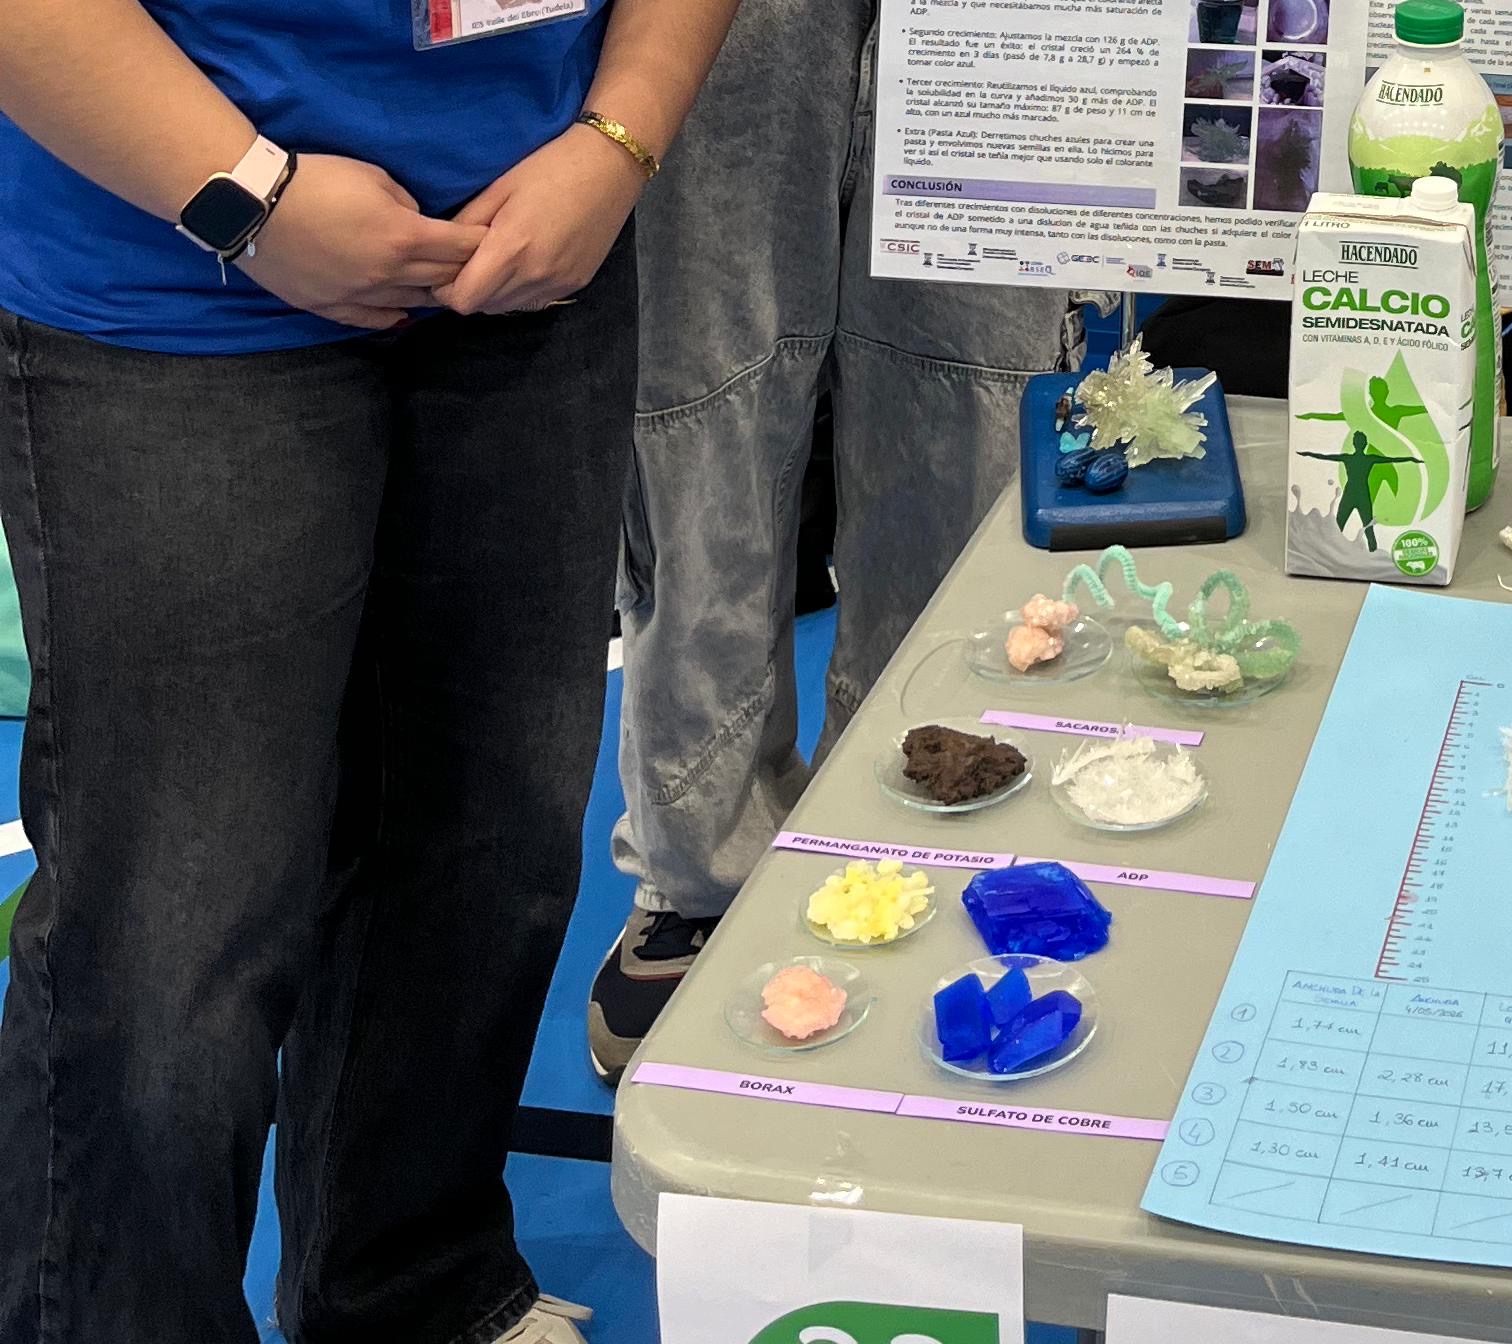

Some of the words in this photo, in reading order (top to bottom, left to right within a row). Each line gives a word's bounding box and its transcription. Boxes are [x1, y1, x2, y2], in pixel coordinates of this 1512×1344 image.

[1375, 83, 1443, 104] HACENDADO
[890, 178, 962, 192] CONCLUSIÓN
[1339, 244, 1418, 267] HACENDADO
[1302, 269, 1358, 283] LECHE
[1302, 286, 1450, 319] CALCIO
[1301, 315, 1450, 337] SEMIDESNATADA
[1117, 871, 1148, 881] ADP
[739, 1079, 795, 1094] BORAX
[956, 1105, 1027, 1120] SULFATO
[1031, 1113, 1054, 1123] DE
[1057, 1115, 1111, 1129] COBRE
